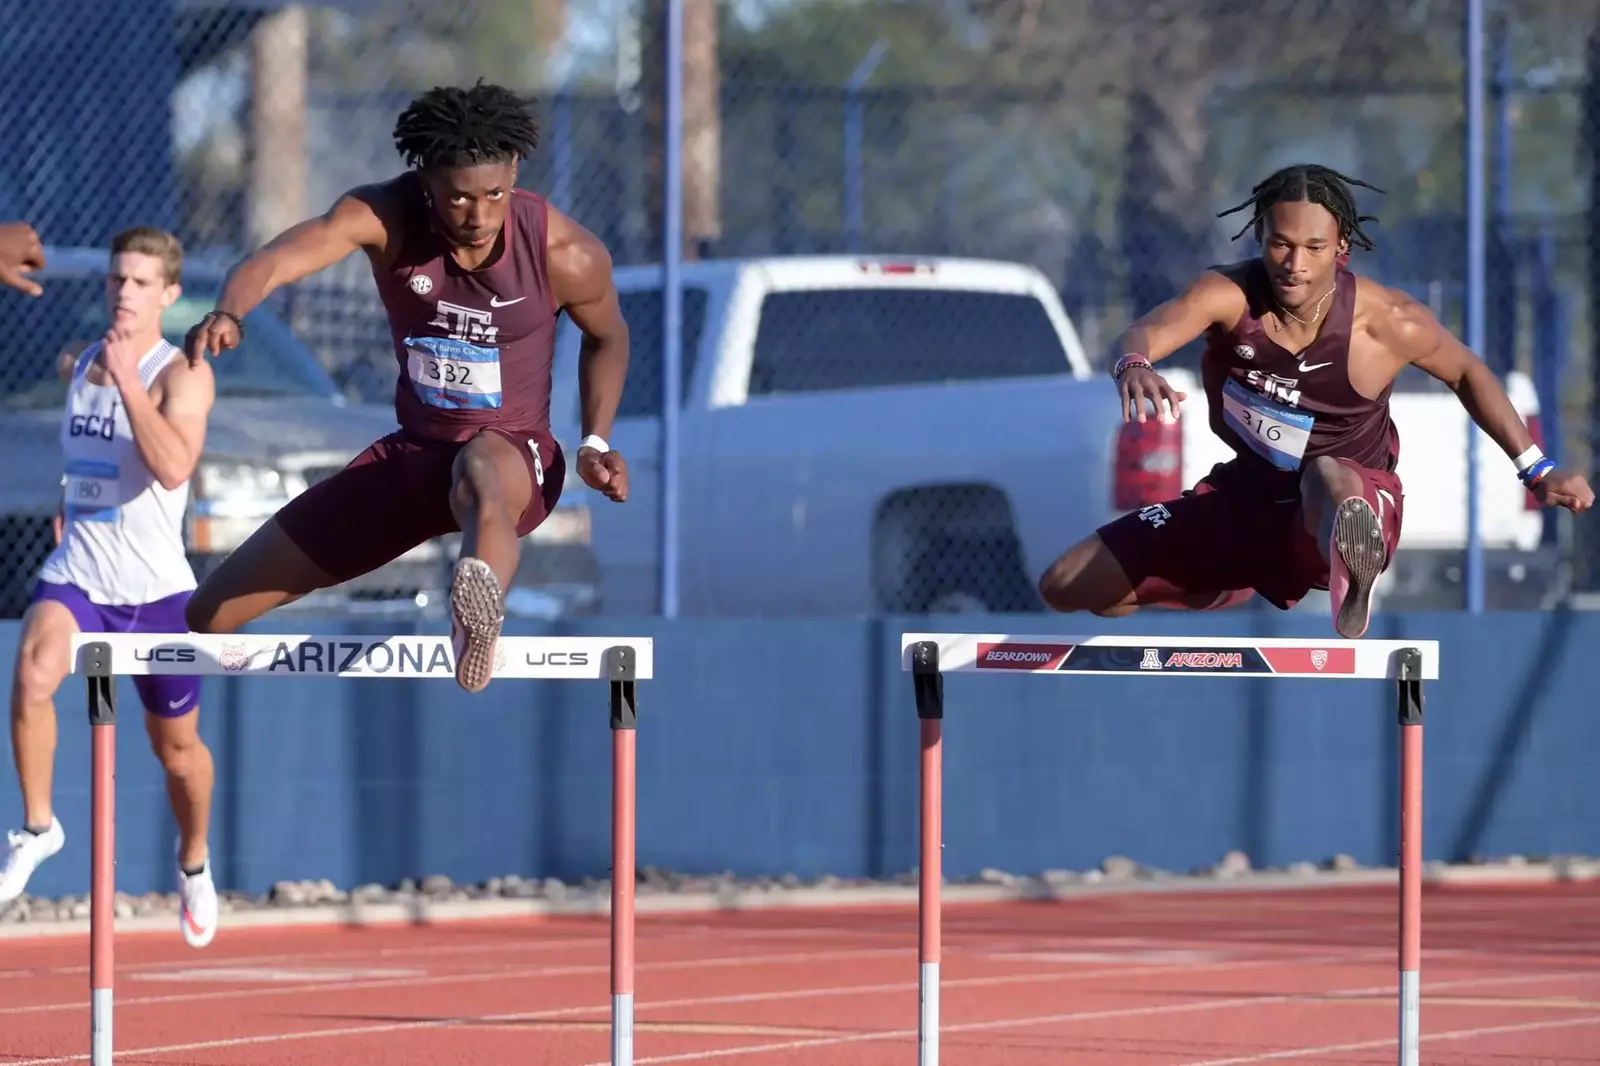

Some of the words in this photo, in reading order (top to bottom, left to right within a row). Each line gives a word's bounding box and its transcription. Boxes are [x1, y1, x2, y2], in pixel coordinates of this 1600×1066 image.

[428, 361, 473, 385] 332
[1242, 410, 1282, 441] 316
[134, 648, 196, 663] UCS
[268, 641, 453, 673] ARIZONA
[526, 652, 589, 666] UCS
[1165, 652, 1242, 668] ARIZONA
